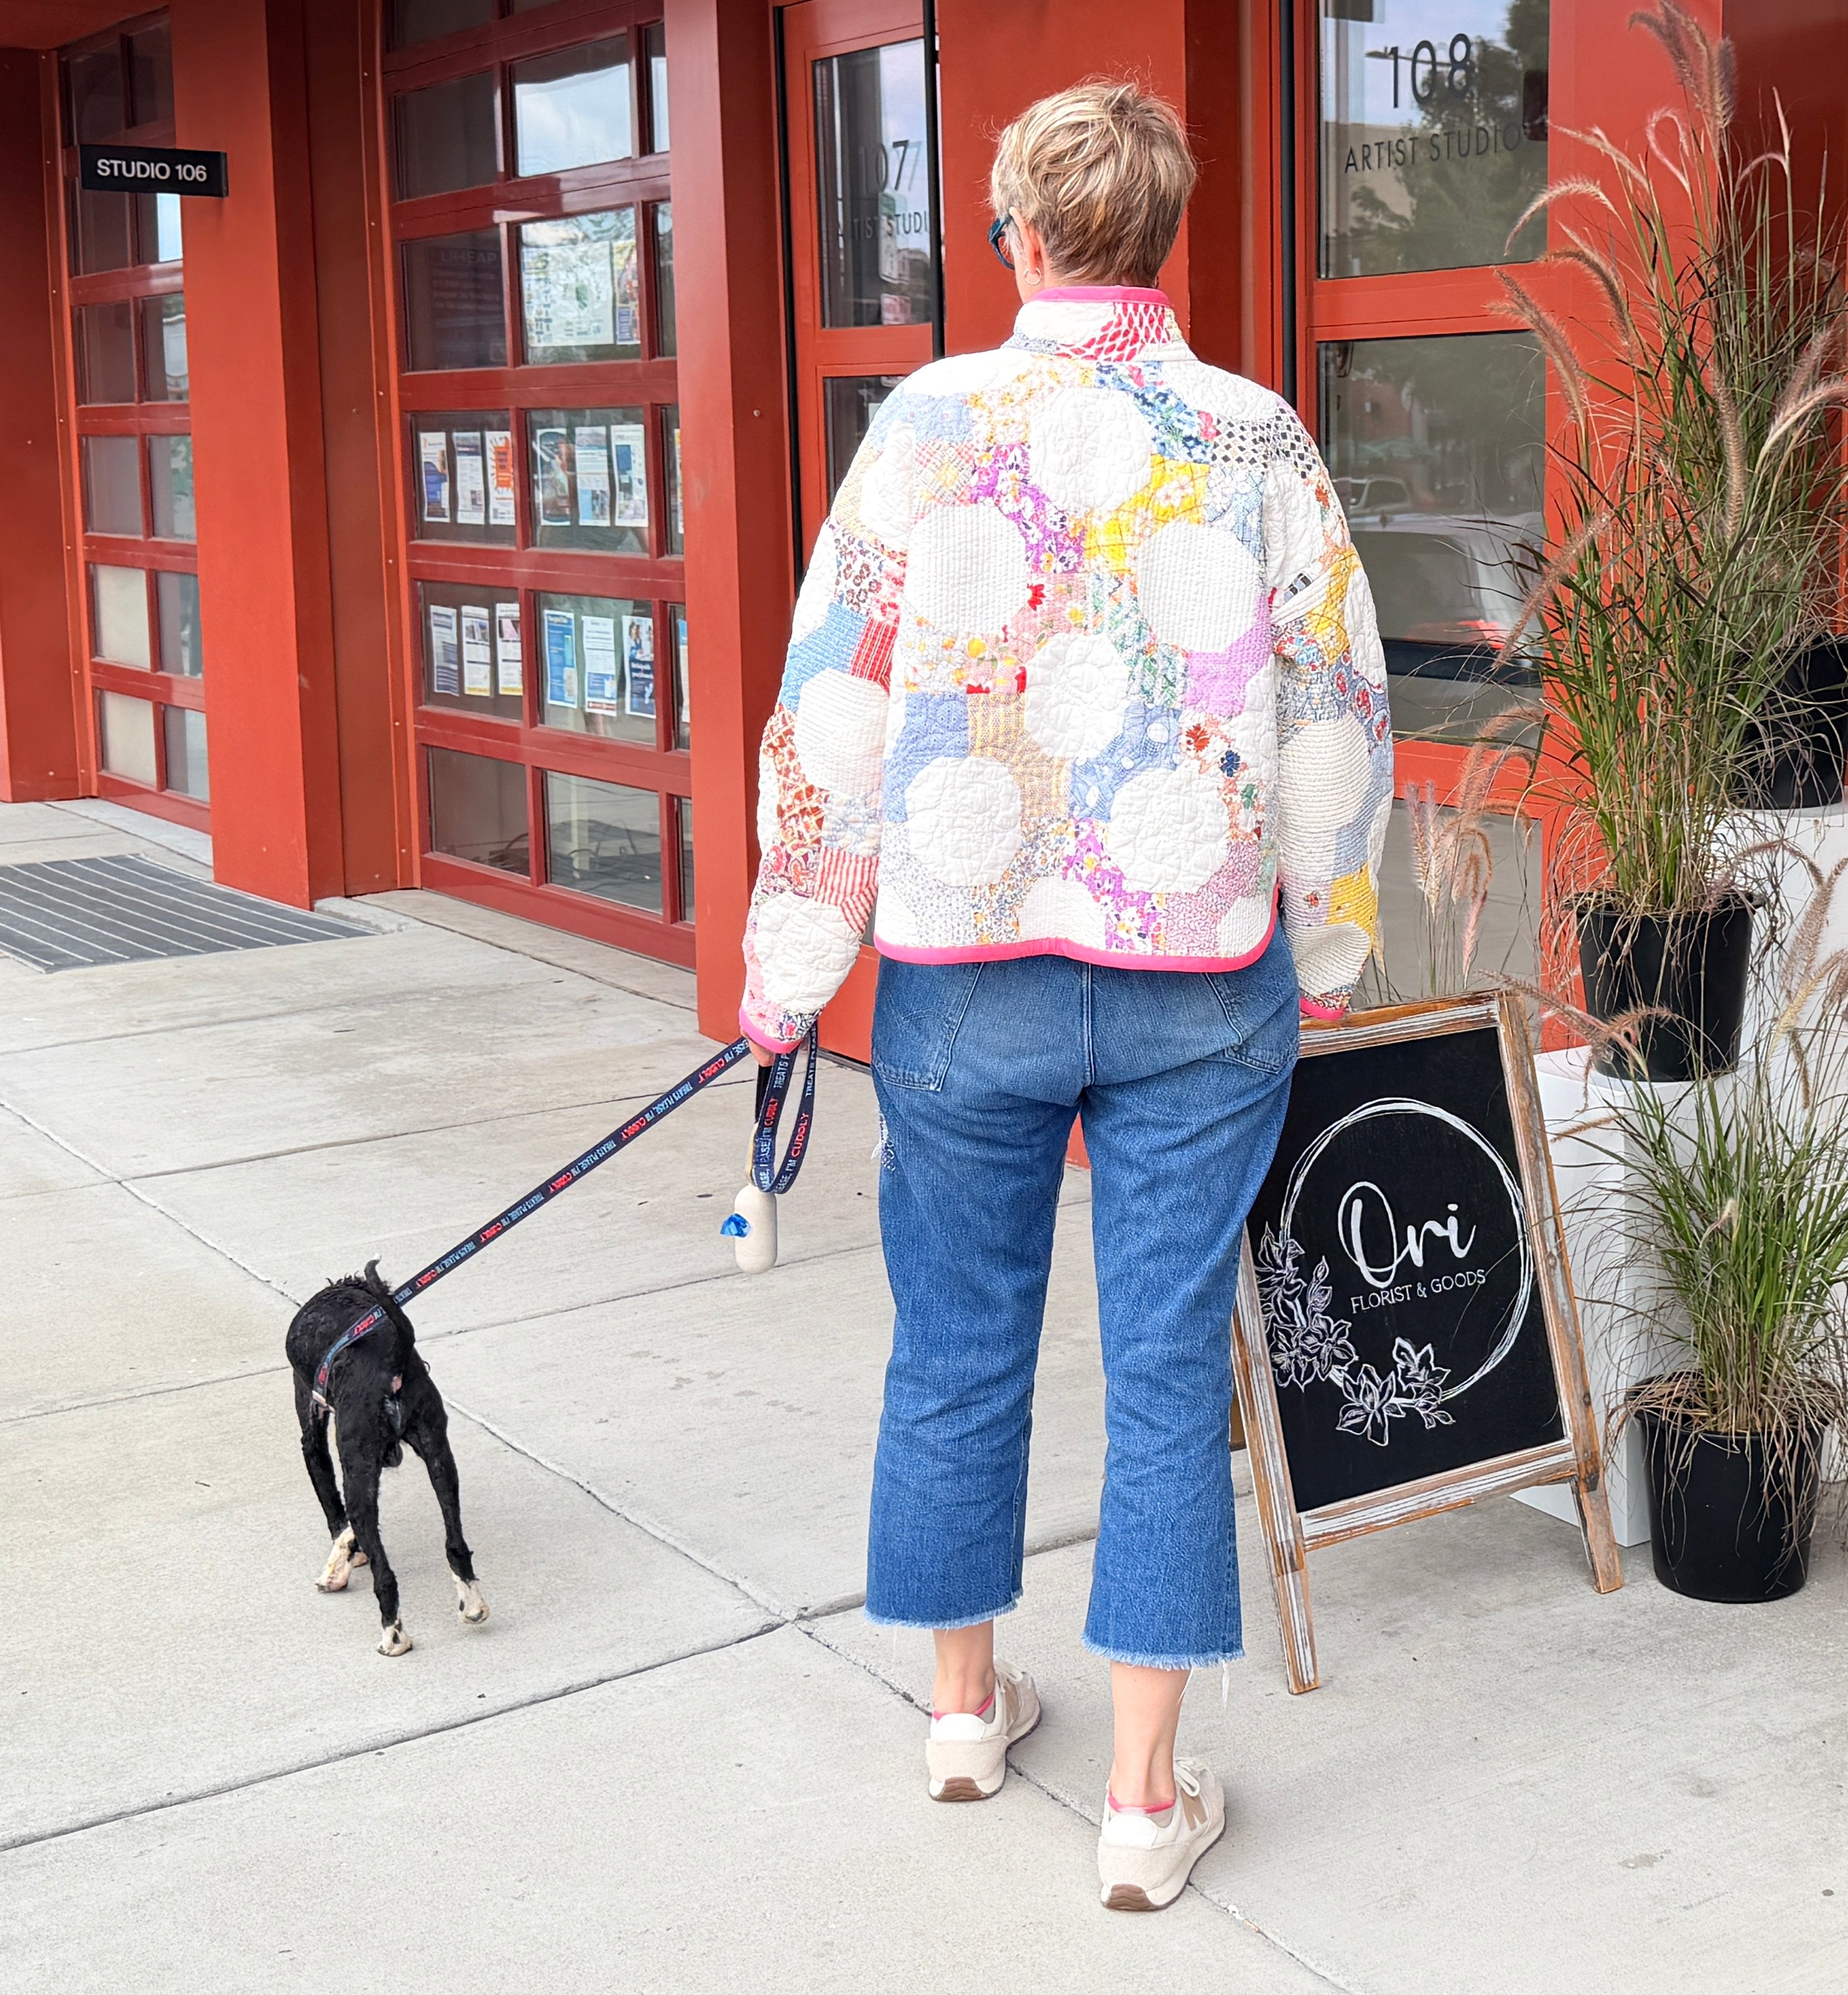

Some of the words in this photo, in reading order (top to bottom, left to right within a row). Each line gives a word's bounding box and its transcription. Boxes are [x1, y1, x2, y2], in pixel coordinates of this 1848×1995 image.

[1389, 33, 1471, 108] 108
[97, 158, 171, 179] STUDIO
[174, 164, 207, 182] 106
[1344, 137, 1419, 173] ARTIST
[1429, 122, 1521, 162] STUDIO
[886, 210, 928, 237] STUDI
[792, 1113, 809, 1157] CUDDLY
[1338, 1181, 1476, 1288] Ori
[1350, 1284, 1413, 1314] FLORIST
[1416, 1282, 1428, 1298] &
[1430, 1269, 1486, 1293] GOODS
